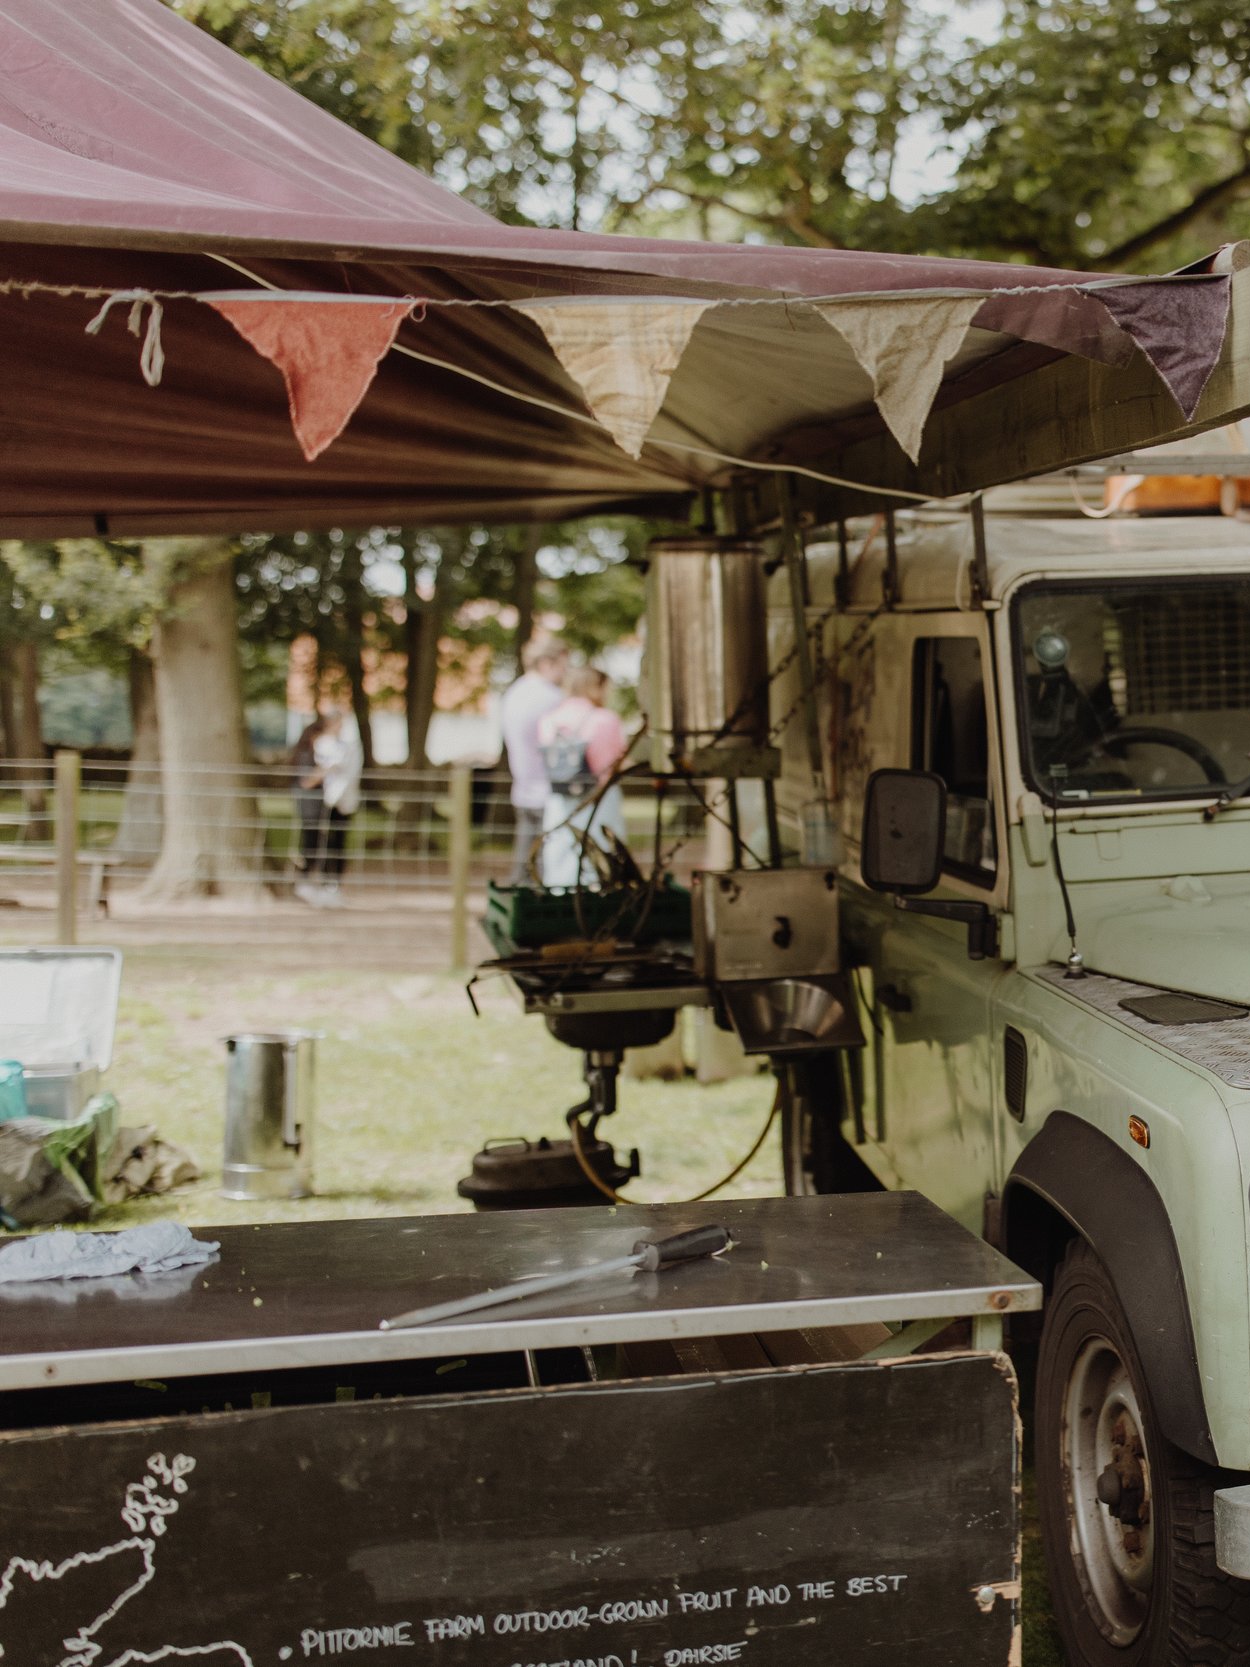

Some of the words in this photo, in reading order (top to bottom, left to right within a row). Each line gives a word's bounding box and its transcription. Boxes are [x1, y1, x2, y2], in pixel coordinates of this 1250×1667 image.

[423, 1614, 485, 1643] FARM
[493, 1599, 669, 1634] OUTDOOR-GROWN
[675, 1588, 738, 1613] FRUIT
[746, 1584, 791, 1607] AND
[797, 1581, 836, 1601] THE
[846, 1574, 908, 1596] BEST
[664, 1640, 748, 1667] DAIRSIE
